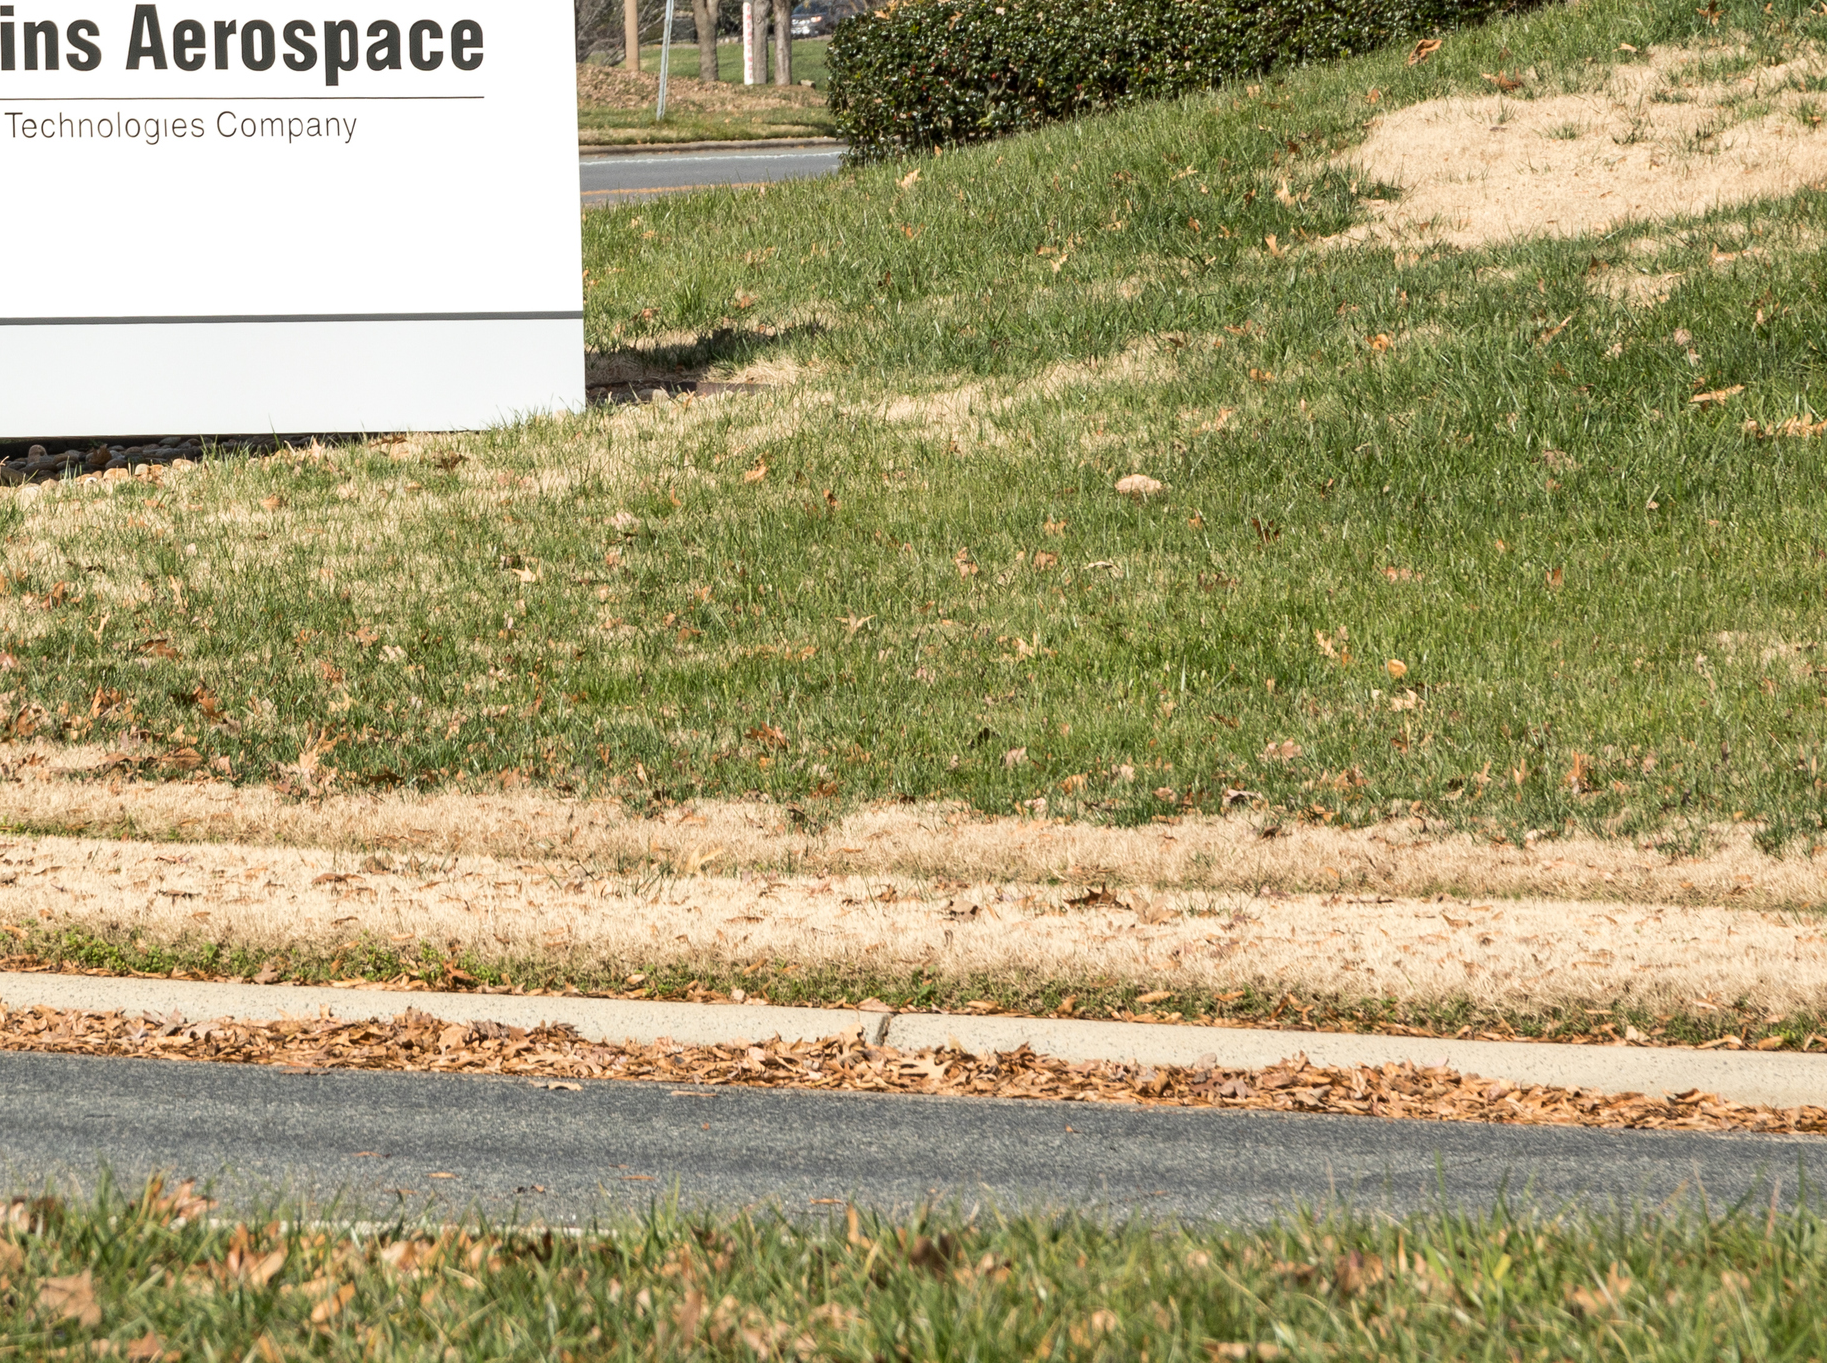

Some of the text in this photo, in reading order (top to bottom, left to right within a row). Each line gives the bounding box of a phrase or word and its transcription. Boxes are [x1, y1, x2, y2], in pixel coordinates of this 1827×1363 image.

[125, 4, 485, 87] Aerospace
[3, 111, 205, 146] Technologies
[216, 110, 358, 146] Company
